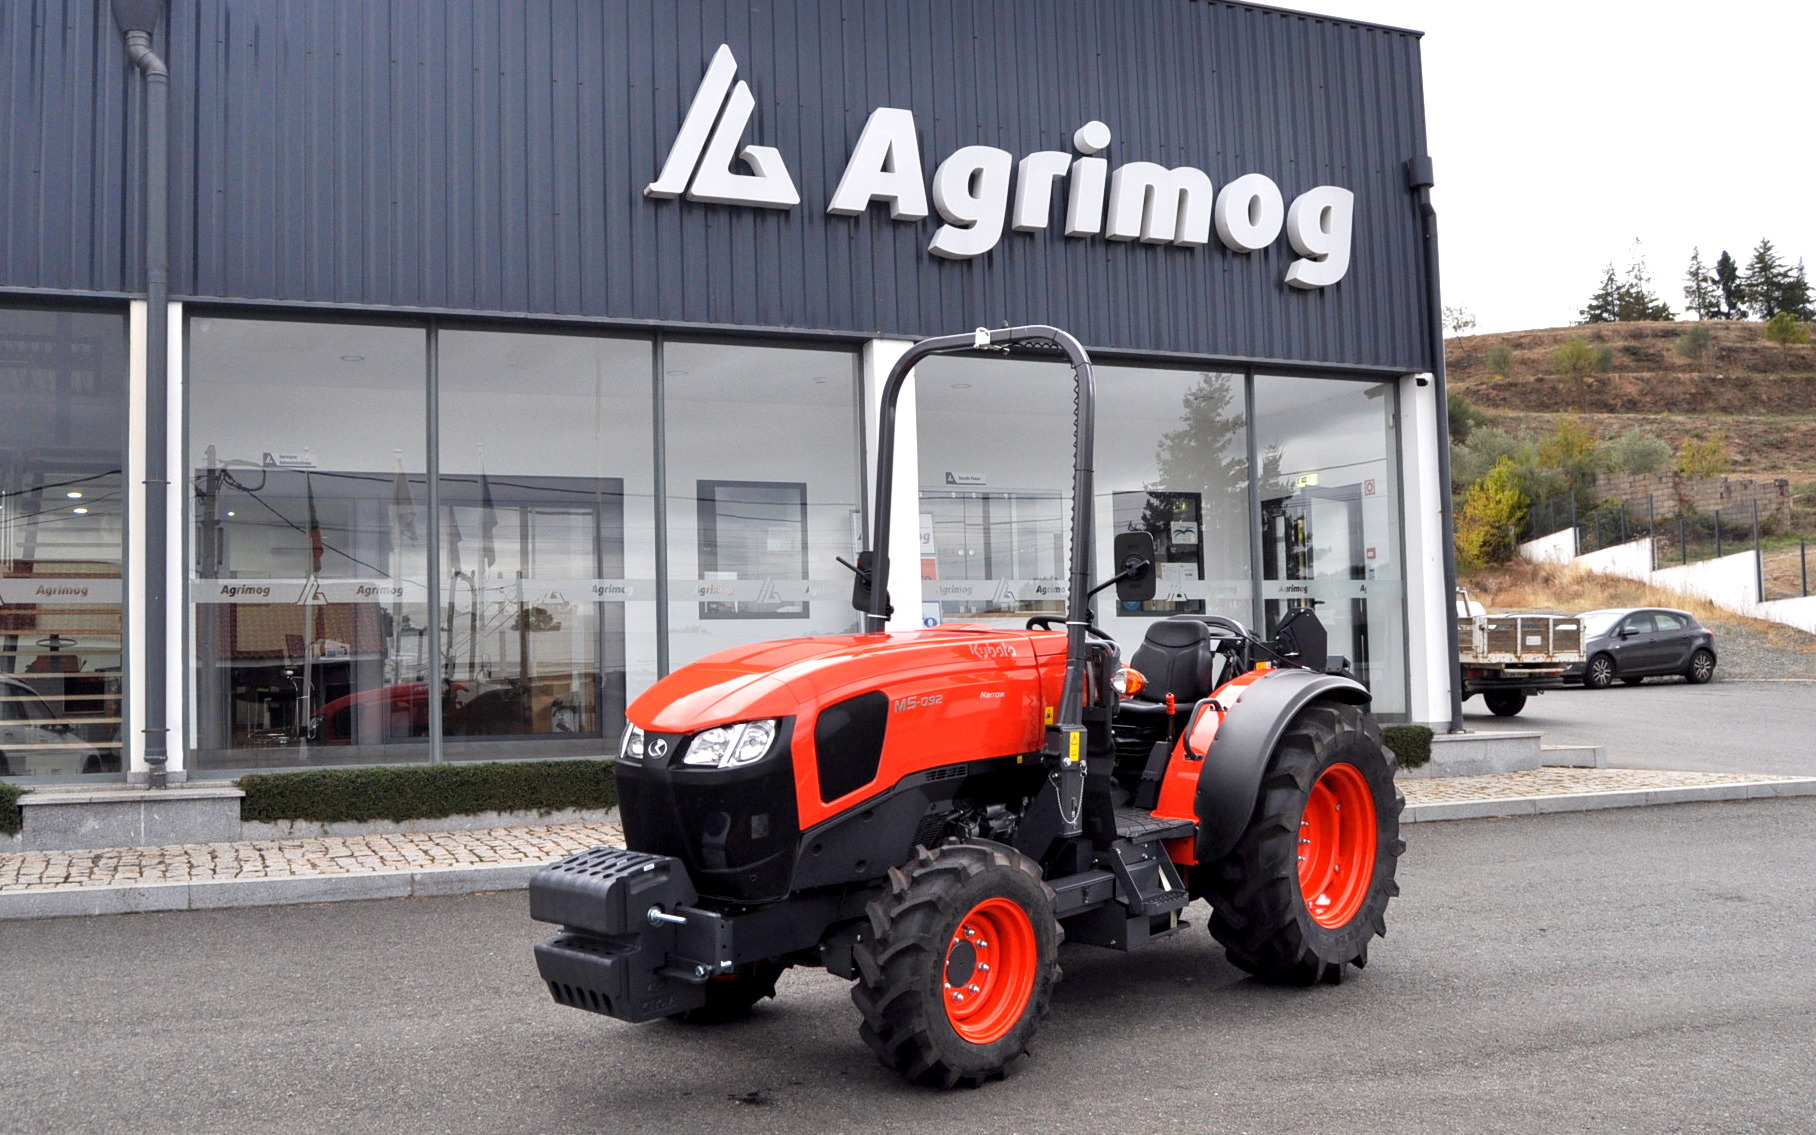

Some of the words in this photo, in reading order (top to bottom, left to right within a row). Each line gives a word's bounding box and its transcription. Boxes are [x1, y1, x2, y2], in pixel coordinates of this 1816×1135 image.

[826, 107, 1354, 289] Agrimog
[36, 584, 89, 597] Agrimog
[220, 584, 271, 597] Agrimog
[356, 584, 404, 597] Agrimog
[968, 642, 1017, 659] Kubota
[894, 694, 943, 713] M5-092
[979, 691, 1006, 699] Narrow
